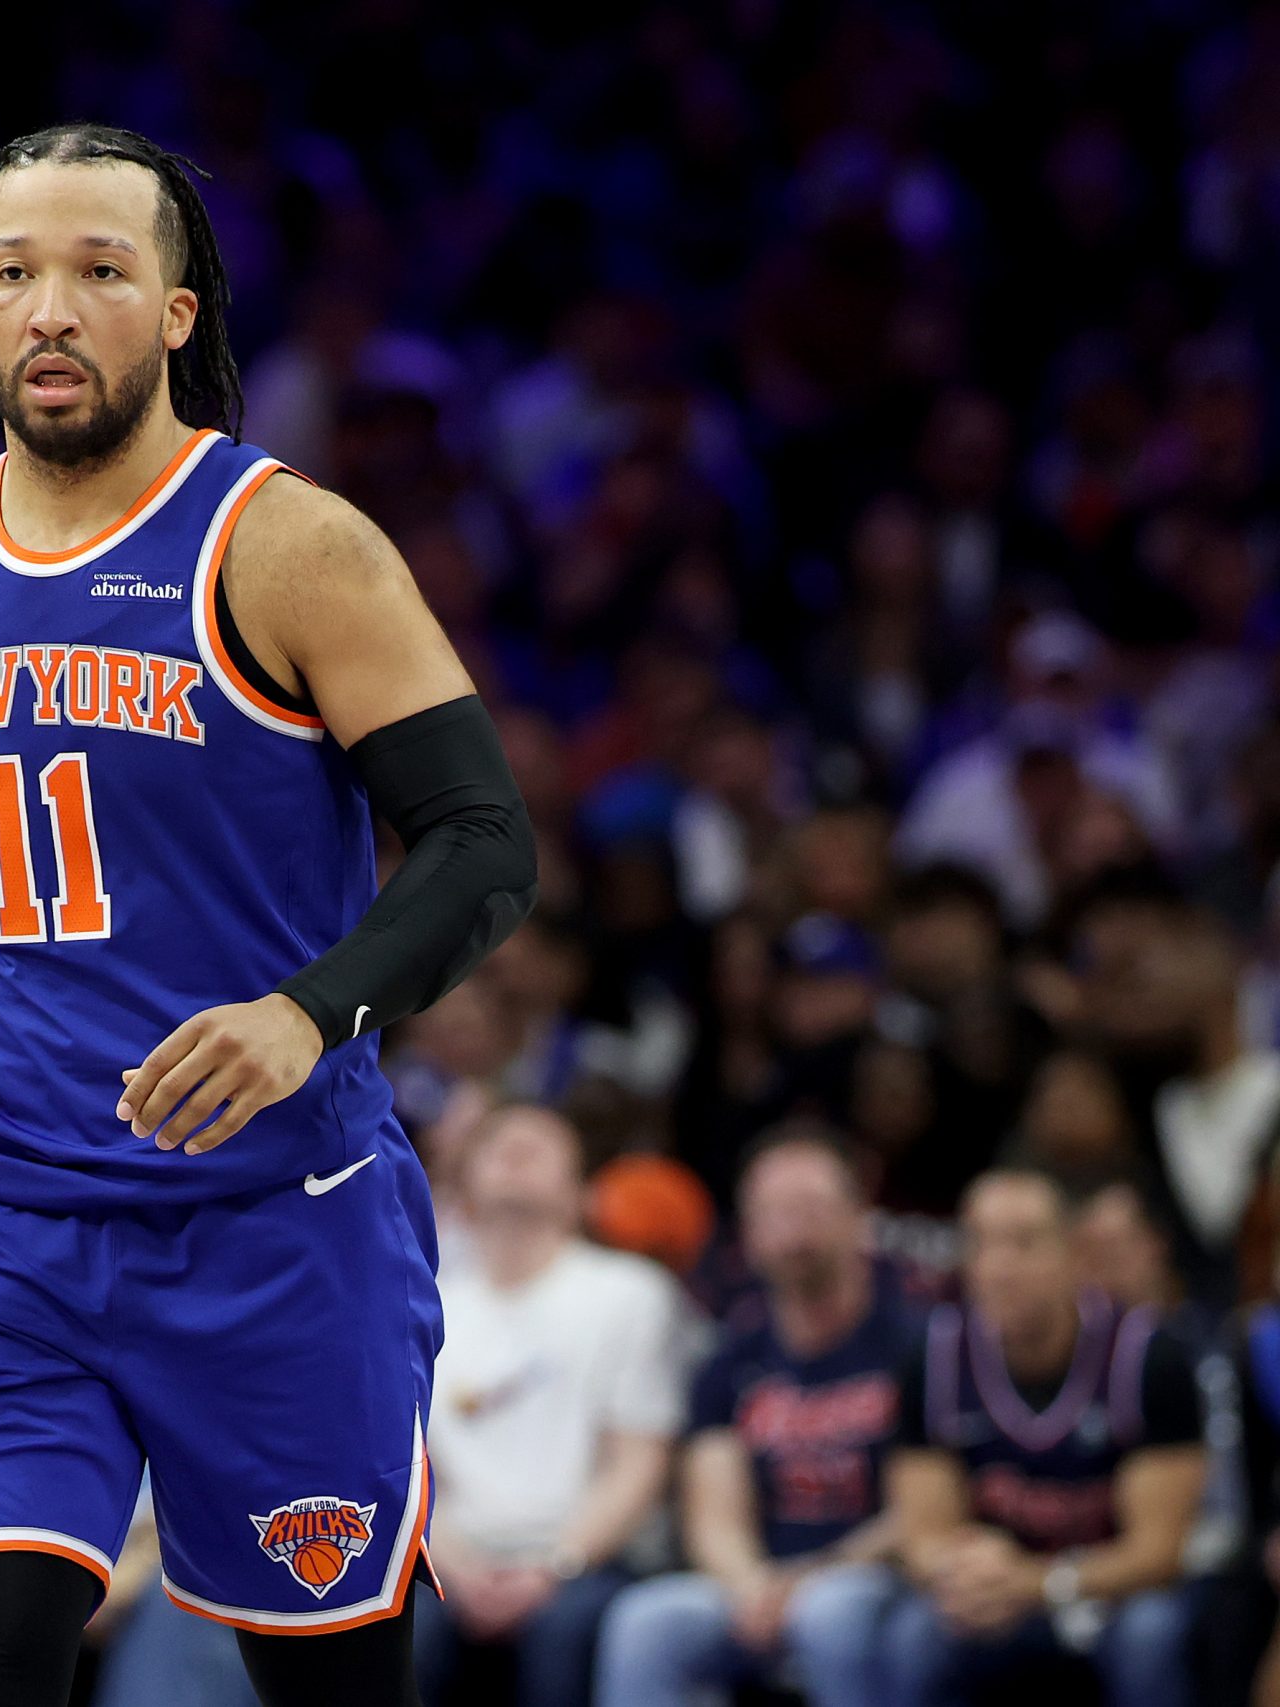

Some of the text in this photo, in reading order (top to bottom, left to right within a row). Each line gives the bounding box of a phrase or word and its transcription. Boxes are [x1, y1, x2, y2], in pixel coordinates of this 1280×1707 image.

[93, 572, 143, 581] experience
[90, 581, 184, 600] abu dhabi
[23, 643, 206, 746] YORK
[292, 1500, 338, 1514] NEW YORK
[261, 1505, 370, 1551] KNICKS
